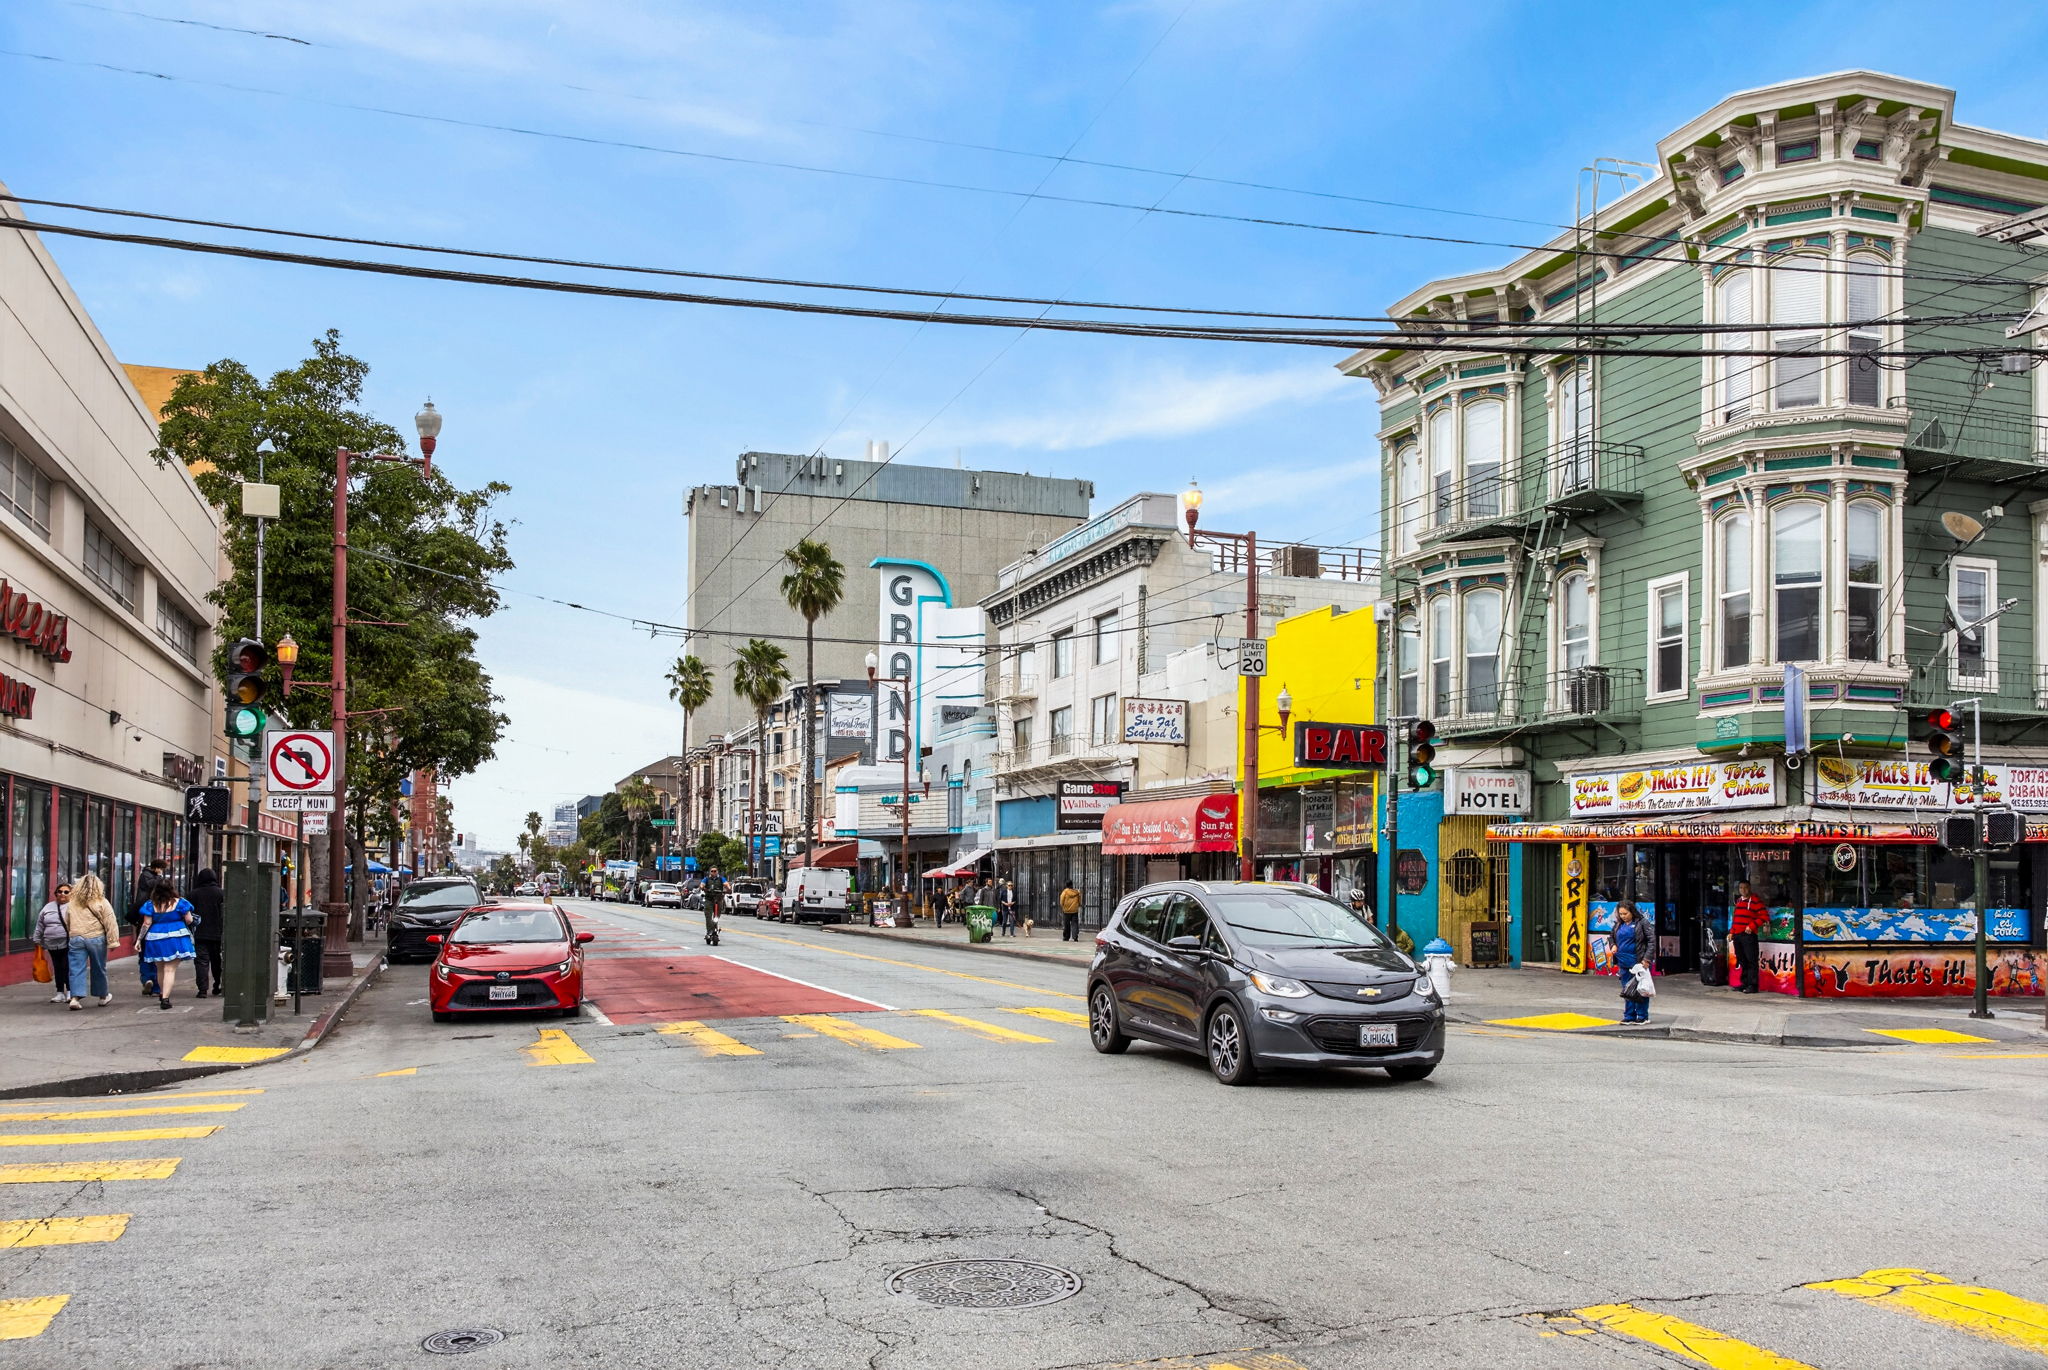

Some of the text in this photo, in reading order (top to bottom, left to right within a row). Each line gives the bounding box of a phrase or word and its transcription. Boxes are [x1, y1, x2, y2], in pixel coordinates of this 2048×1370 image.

[1241, 642, 1265, 650] SPEED
[889, 575, 912, 760] GRAND
[1242, 658, 1264, 673] 20
[1134, 714, 1176, 728] Sun Fat
[1126, 726, 1184, 740] Seafood Co.
[1305, 728, 1386, 763] BAR
[1724, 762, 1767, 780] Torta
[1862, 760, 1909, 785] That's
[1468, 776, 1516, 789] Norma
[1576, 777, 1609, 794] Torta
[1651, 768, 1688, 791] That's
[1063, 783, 1118, 795] GameStop
[1722, 779, 1771, 799] Cubana
[272, 798, 328, 809] EXCEPT MUNI
[1062, 800, 1101, 810] Wallbeds
[1461, 793, 1521, 808] HOTEL
[1574, 793, 1614, 811] Cubana
[1677, 796, 1686, 808] of
[1858, 791, 1871, 805] The
[1871, 792, 1897, 805] Center
[1897, 793, 1907, 806] of
[1200, 821, 1234, 830] Sun Fat
[1561, 825, 1590, 837] WORLD
[1595, 825, 1637, 837] LARGEST
[1643, 825, 1672, 837] TORTA
[1678, 824, 1720, 837] CUBANA
[1798, 823, 1848, 837] THAT'S
[1746, 850, 1790, 861] THAT'S IT
[1777, 952, 1794, 971] it!
[1865, 960, 1965, 985] That's it!
